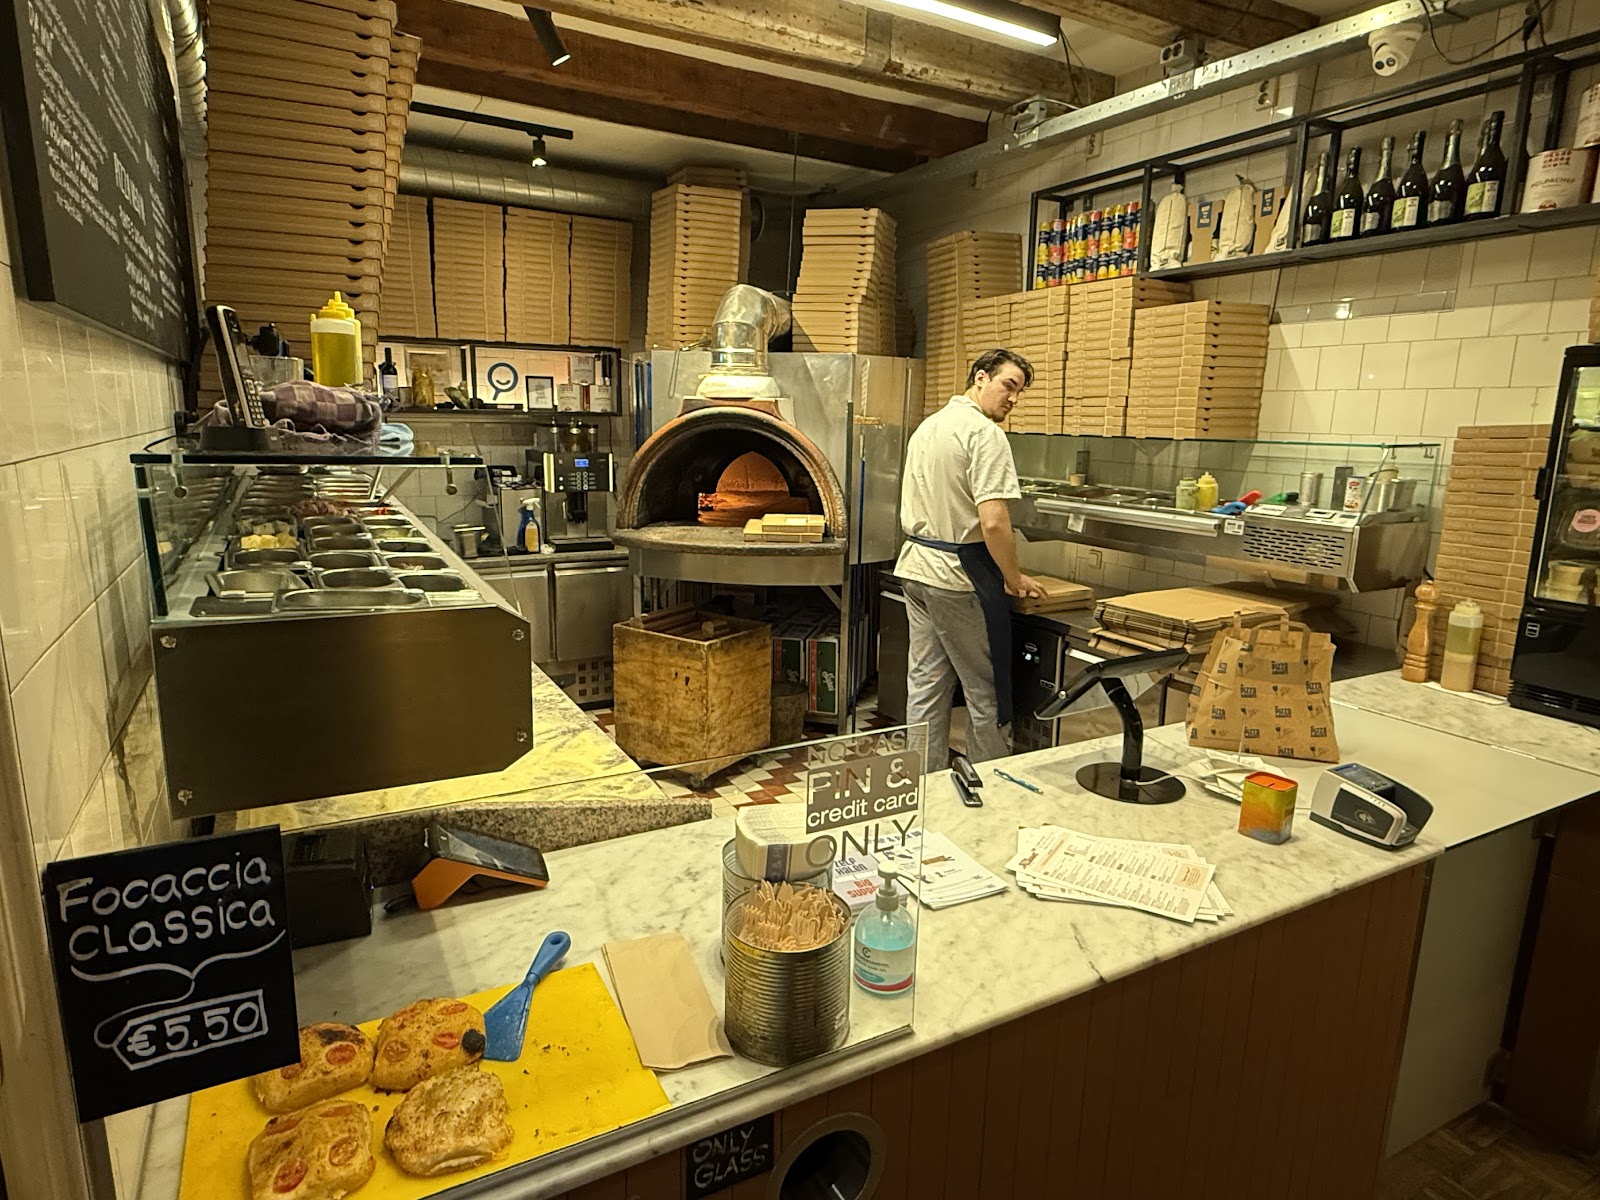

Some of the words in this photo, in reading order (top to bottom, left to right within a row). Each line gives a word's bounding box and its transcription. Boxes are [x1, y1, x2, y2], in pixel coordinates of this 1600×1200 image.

[808, 742, 847, 766] NO
[808, 764, 872, 805] PIN
[886, 758, 912, 788] &
[807, 799, 868, 828] credit
[873, 787, 918, 813] card
[805, 815, 918, 868] ONLY
[56, 852, 272, 923] Focaccia
[126, 1001, 260, 1057] €5.50
[693, 1126, 754, 1163] ONLY
[694, 1143, 769, 1188] GLASS
